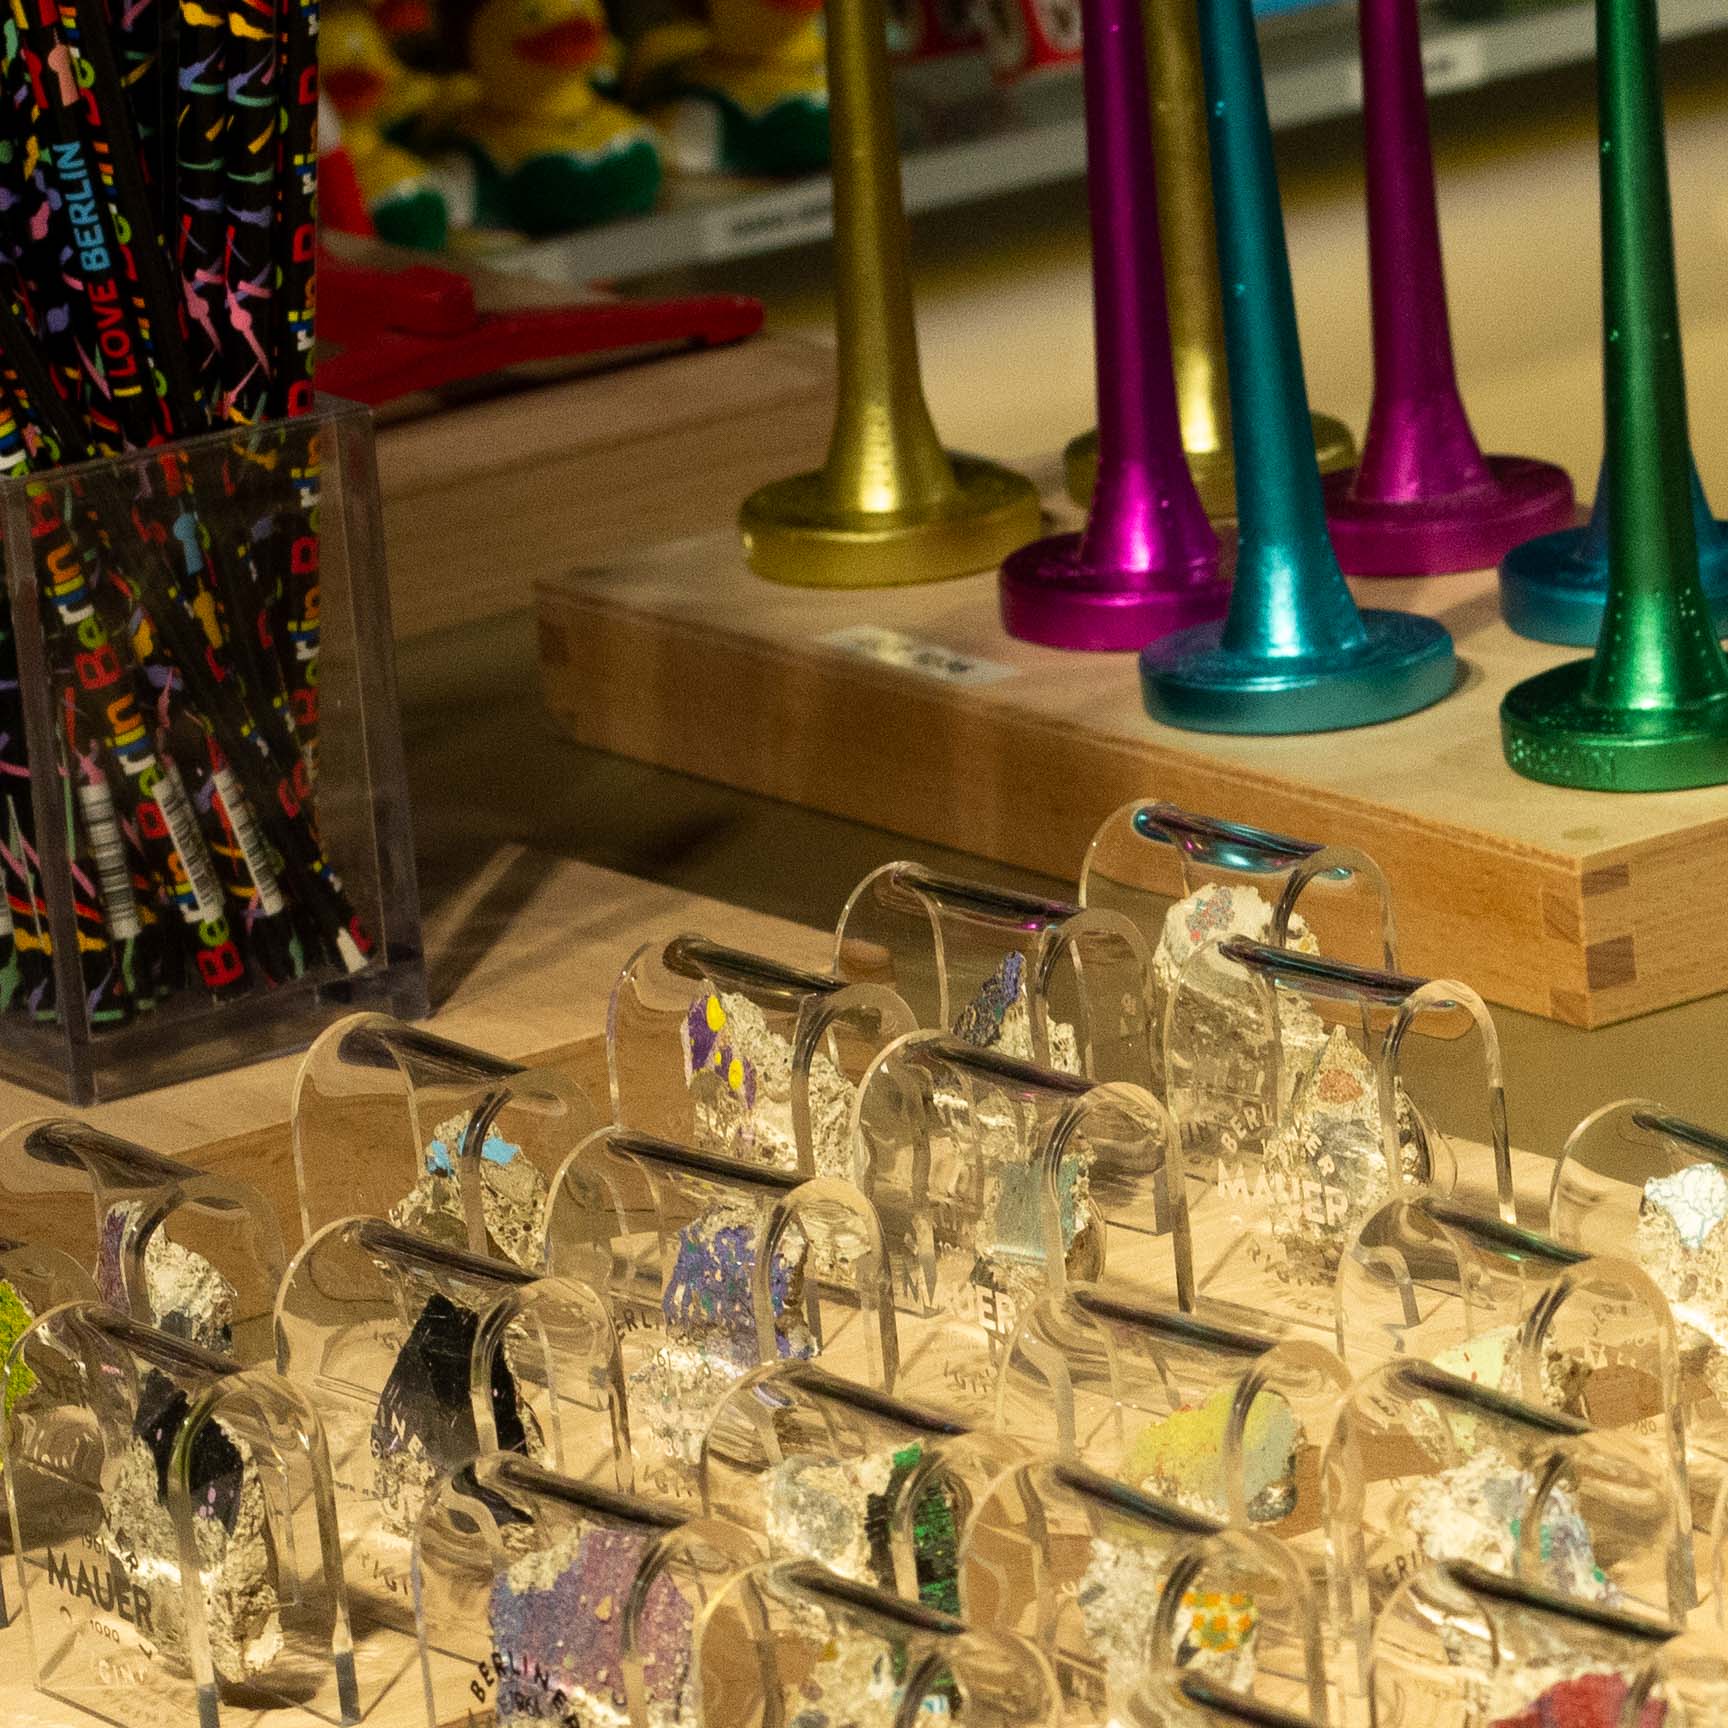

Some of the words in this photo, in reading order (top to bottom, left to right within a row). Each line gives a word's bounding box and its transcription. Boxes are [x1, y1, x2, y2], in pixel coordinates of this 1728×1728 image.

[52, 141, 111, 272] BERLIN
[88, 280, 137, 378] LOVE
[47, 1547, 155, 1634] MAUER
